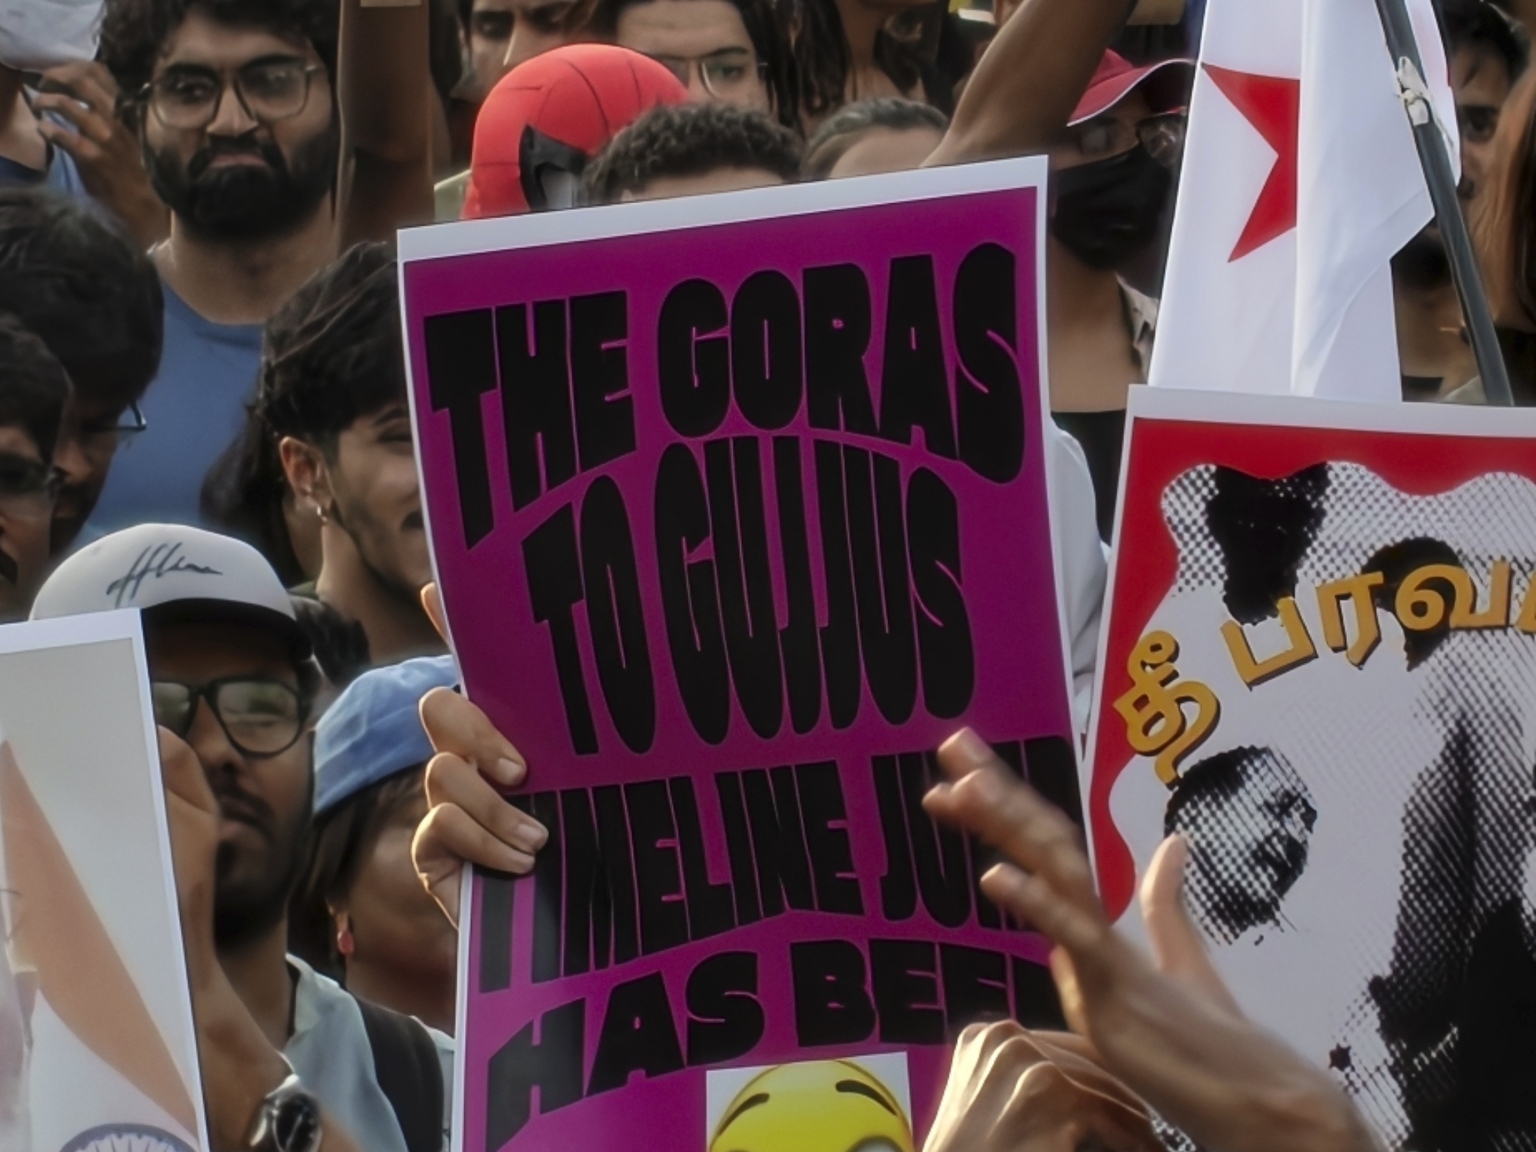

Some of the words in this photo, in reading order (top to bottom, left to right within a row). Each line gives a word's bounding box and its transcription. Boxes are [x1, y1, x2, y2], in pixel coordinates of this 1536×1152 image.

[423, 290, 637, 550] THE
[657, 241, 1024, 485] GORAS
[520, 474, 656, 755] TO
[654, 435, 975, 745] GUJJUS
[1220, 558, 1536, 690] பரவ
